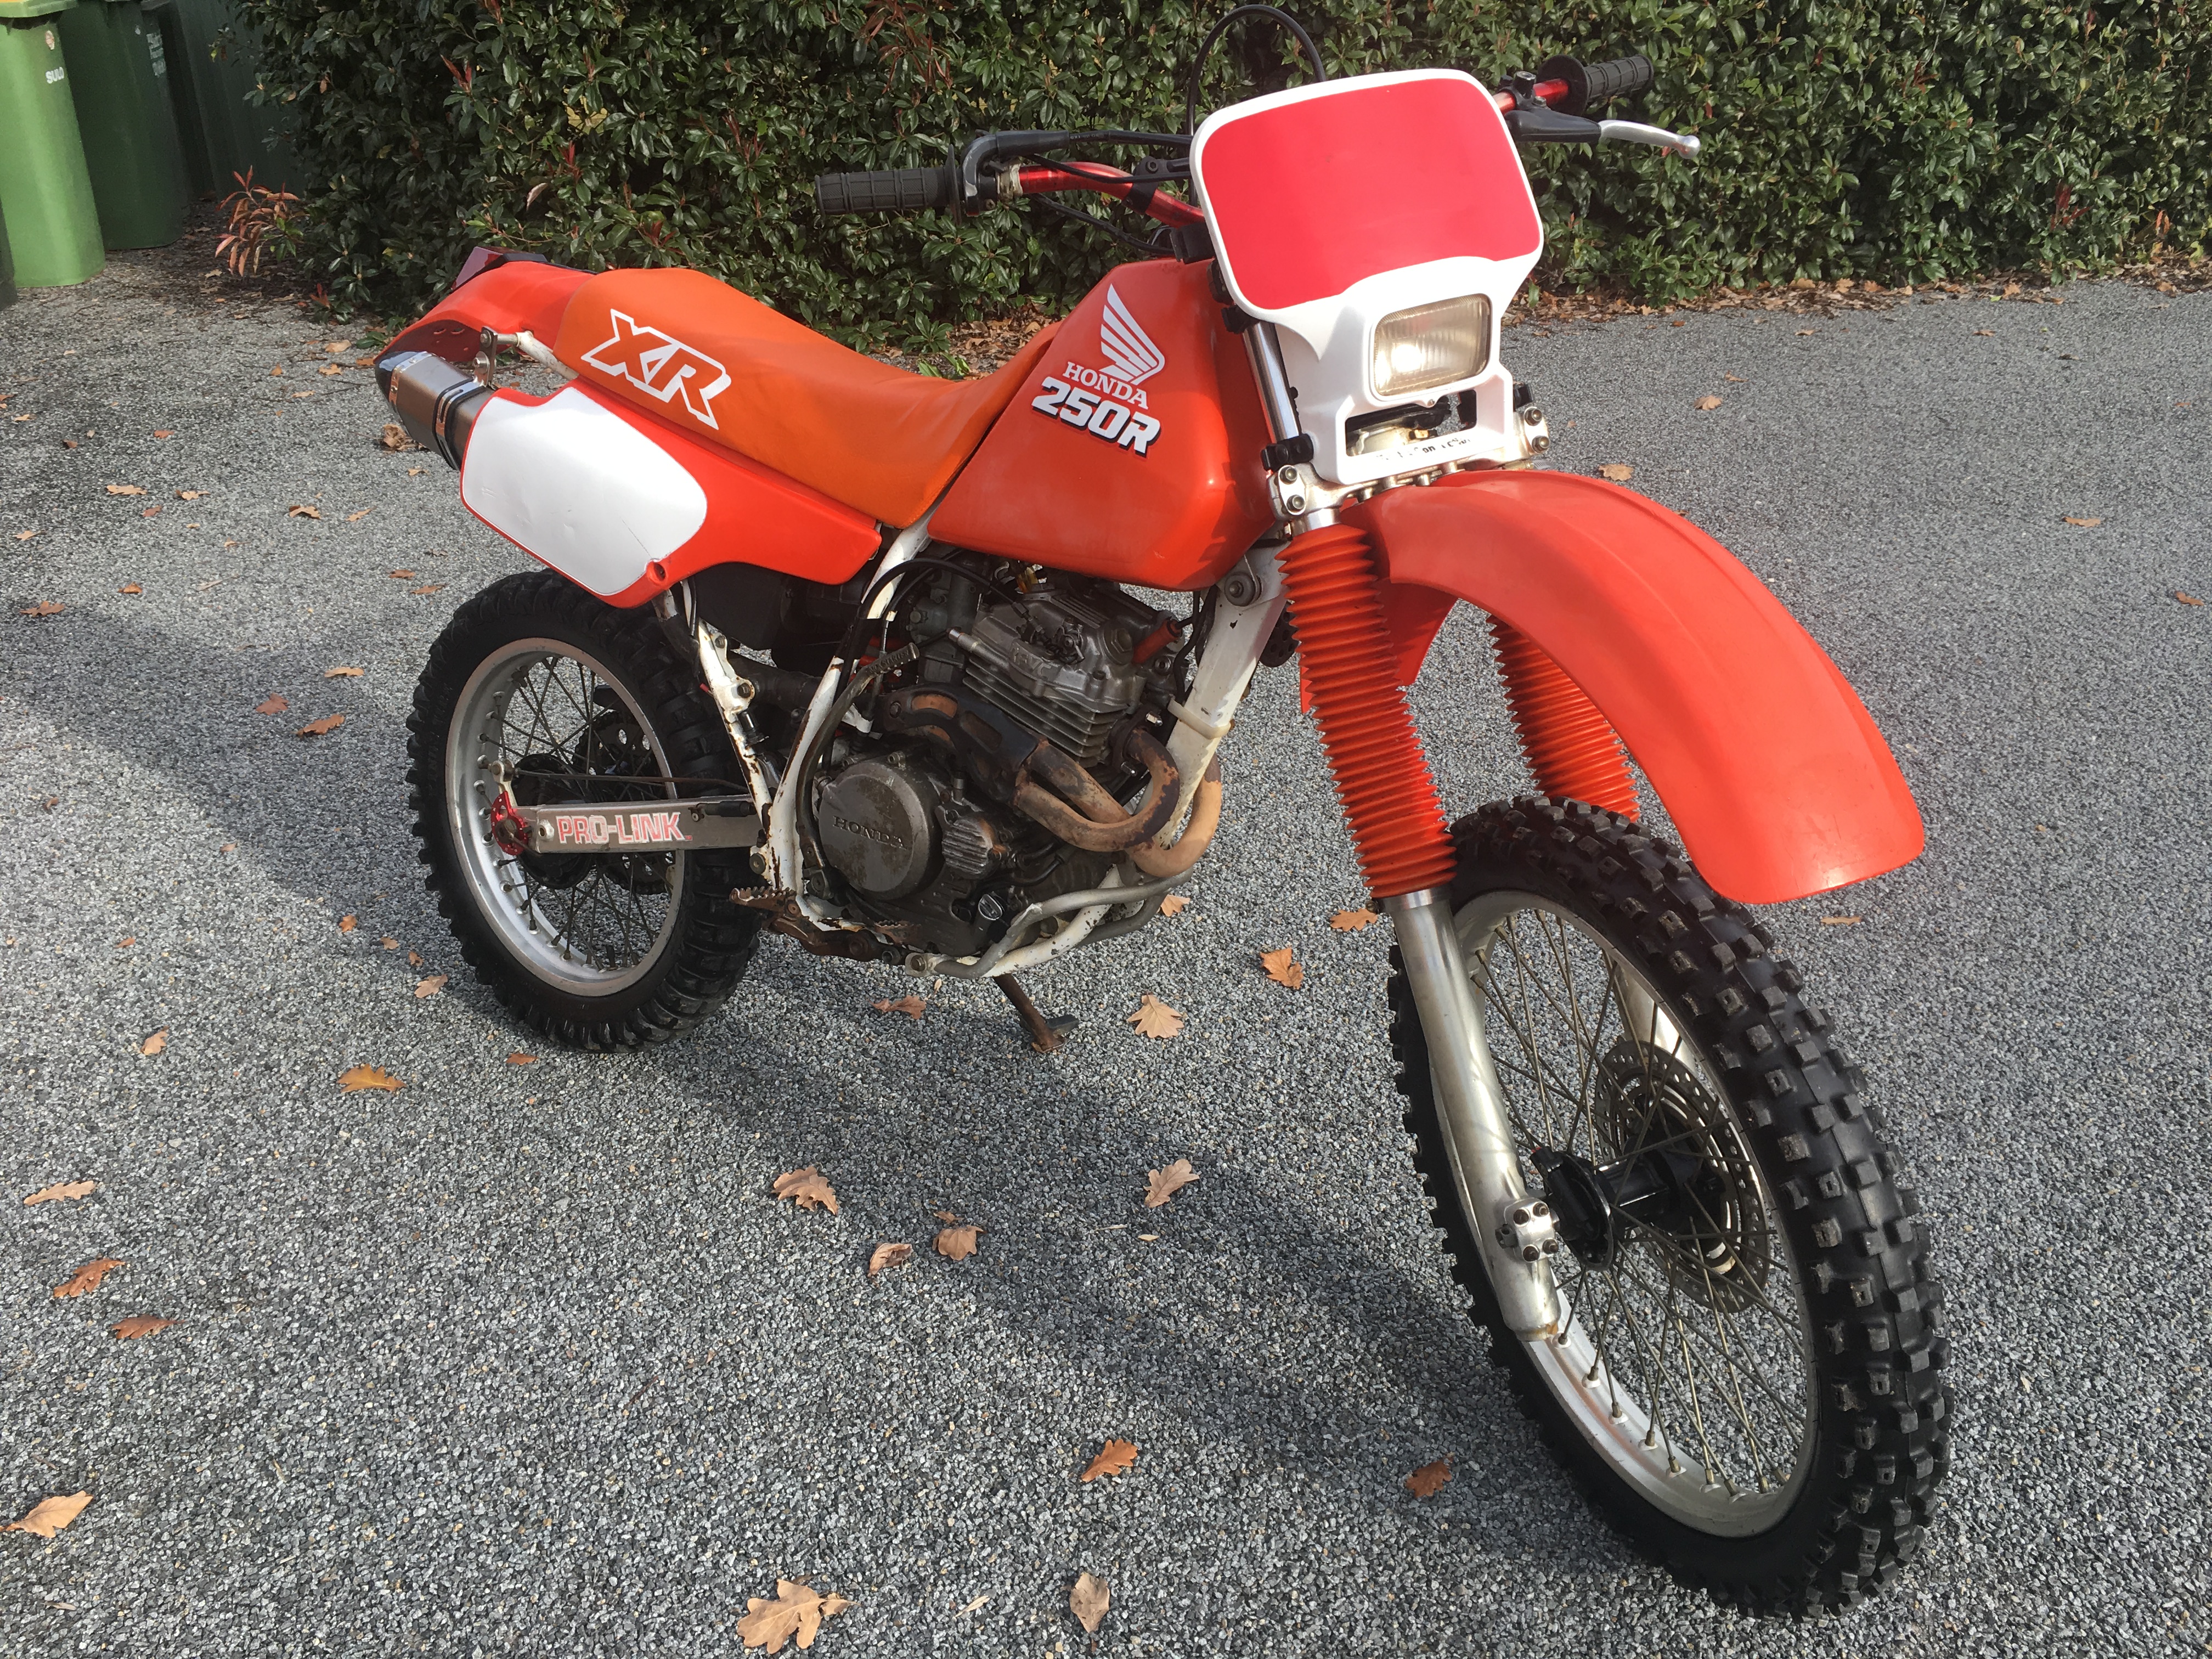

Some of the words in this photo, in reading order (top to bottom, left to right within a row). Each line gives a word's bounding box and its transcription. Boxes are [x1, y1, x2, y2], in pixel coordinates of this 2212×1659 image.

[580, 308, 732, 430] XR
[1062, 361, 1149, 410] HONDA
[1031, 376, 1161, 459] 250R
[556, 812, 686, 844] PRO-LINK
[832, 815, 909, 851] HONDA
